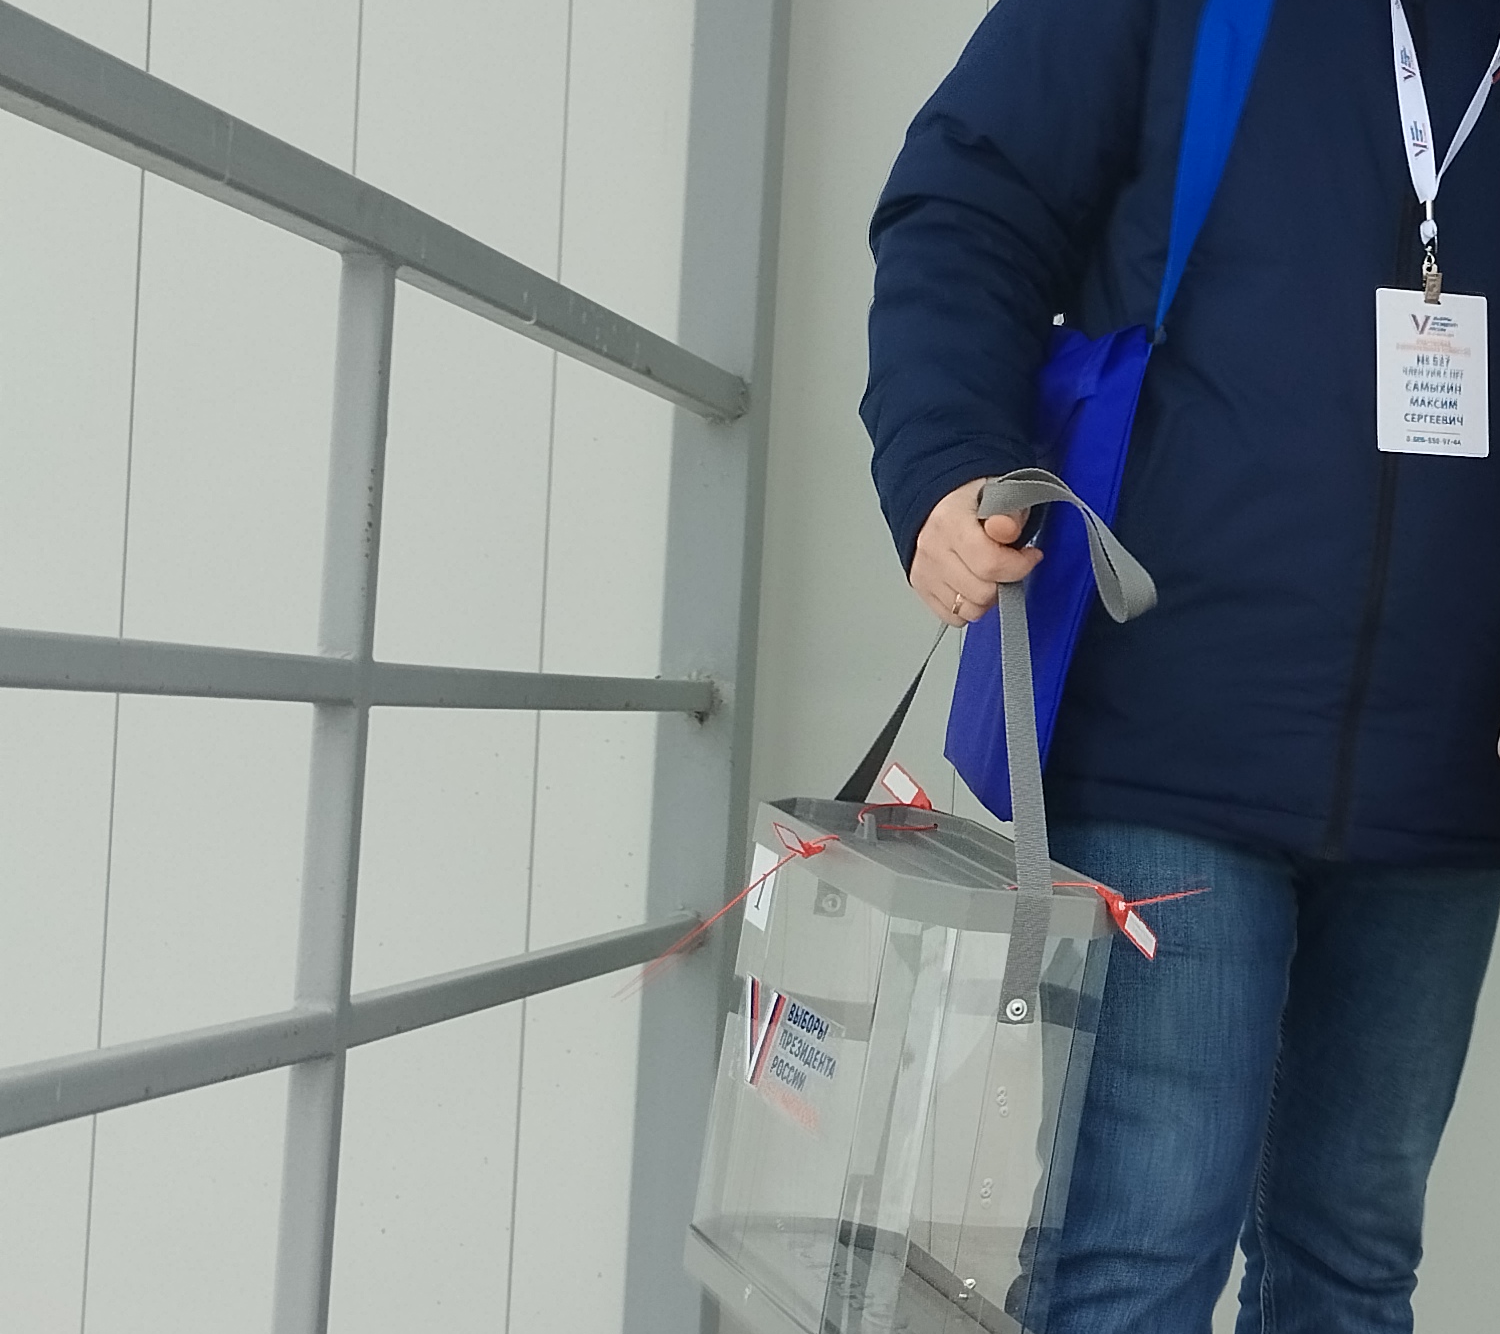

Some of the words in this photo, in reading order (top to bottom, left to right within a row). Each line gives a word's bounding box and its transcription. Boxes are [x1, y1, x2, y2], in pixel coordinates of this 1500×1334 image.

[1403, 412, 1464, 427] СЕРГЕЕВИЧ
[787, 1002, 830, 1043] ВЫБОРЫ
[769, 1055, 807, 1092] РОССИИ
[778, 1029, 837, 1080] ПРЕЗИДЕНТА
